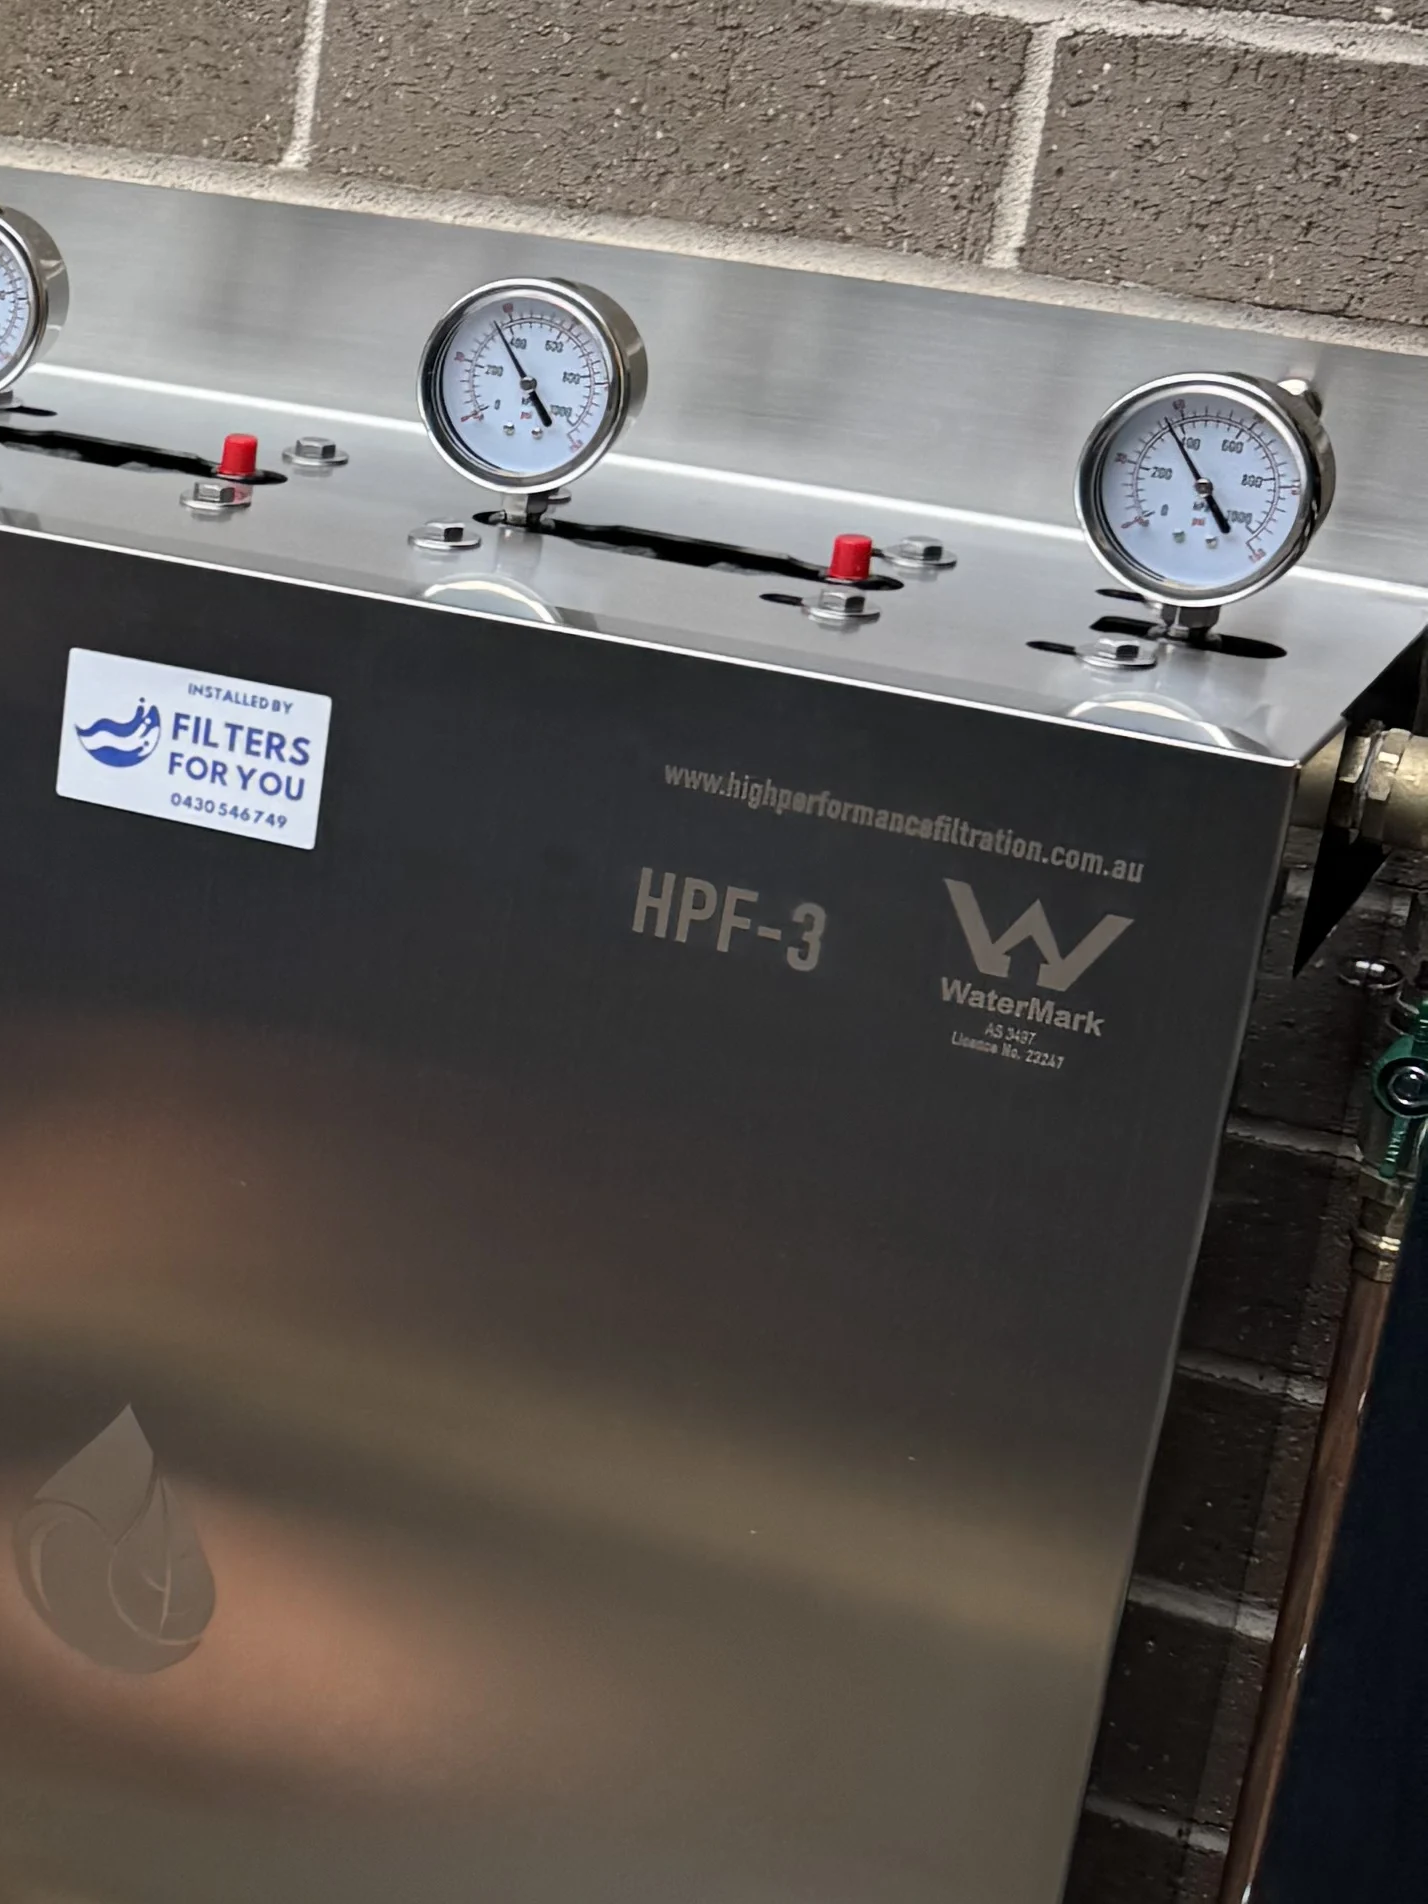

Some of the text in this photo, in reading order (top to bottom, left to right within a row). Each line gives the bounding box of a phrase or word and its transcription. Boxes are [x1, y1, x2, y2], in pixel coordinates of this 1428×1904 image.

[187, 682, 294, 715] INSTALLED BY
[171, 711, 312, 767] FILTERS
[167, 751, 306, 802] FOR YOU
[170, 792, 288, 829] 0430 546 749
[663, 763, 1145, 884] www.highperformancefiltration.com.au
[631, 866, 828, 973] HPF-3
[940, 976, 1106, 1037] WaterMark
